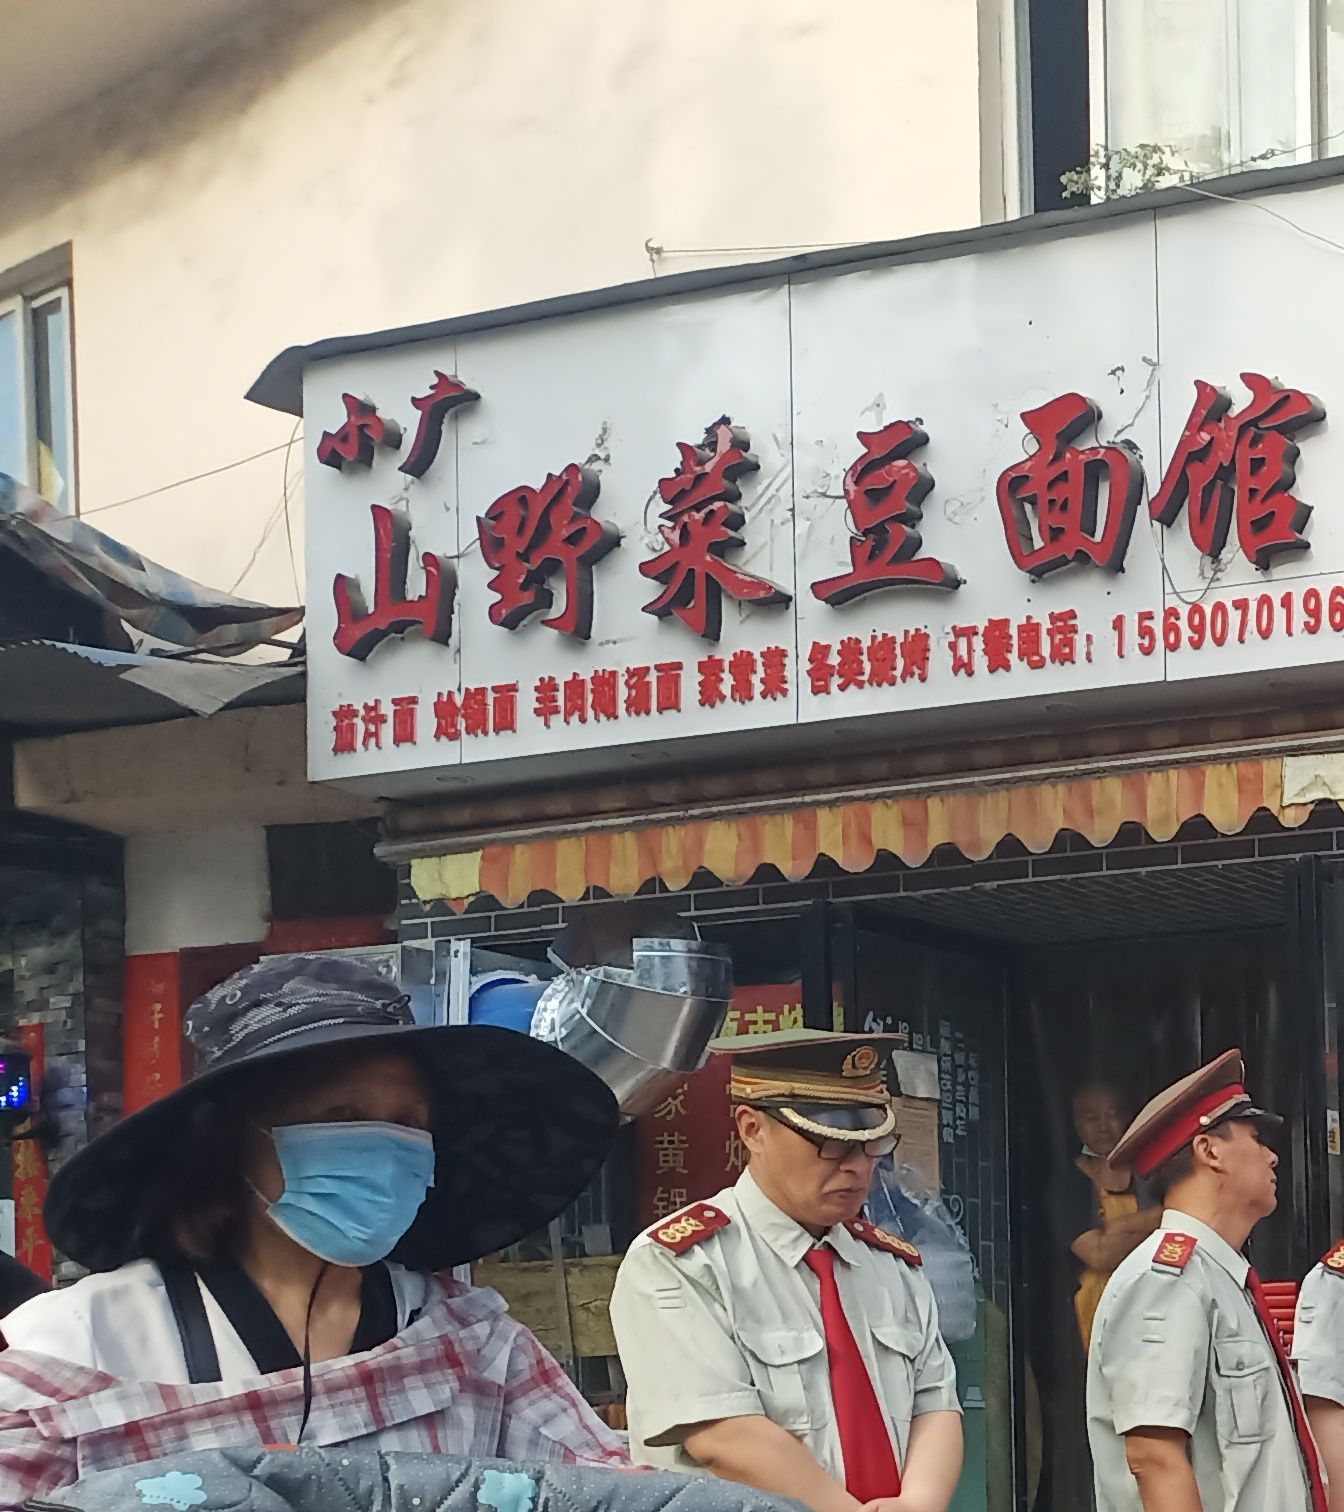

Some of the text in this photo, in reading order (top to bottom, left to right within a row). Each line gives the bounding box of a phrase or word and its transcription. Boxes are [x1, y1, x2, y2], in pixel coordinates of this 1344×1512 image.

[317, 370, 481, 478] 小广
[333, 373, 1327, 661] 山野菜豆面馆
[698, 645, 789, 708] 家常菜
[805, 627, 931, 696] 各类烧烤
